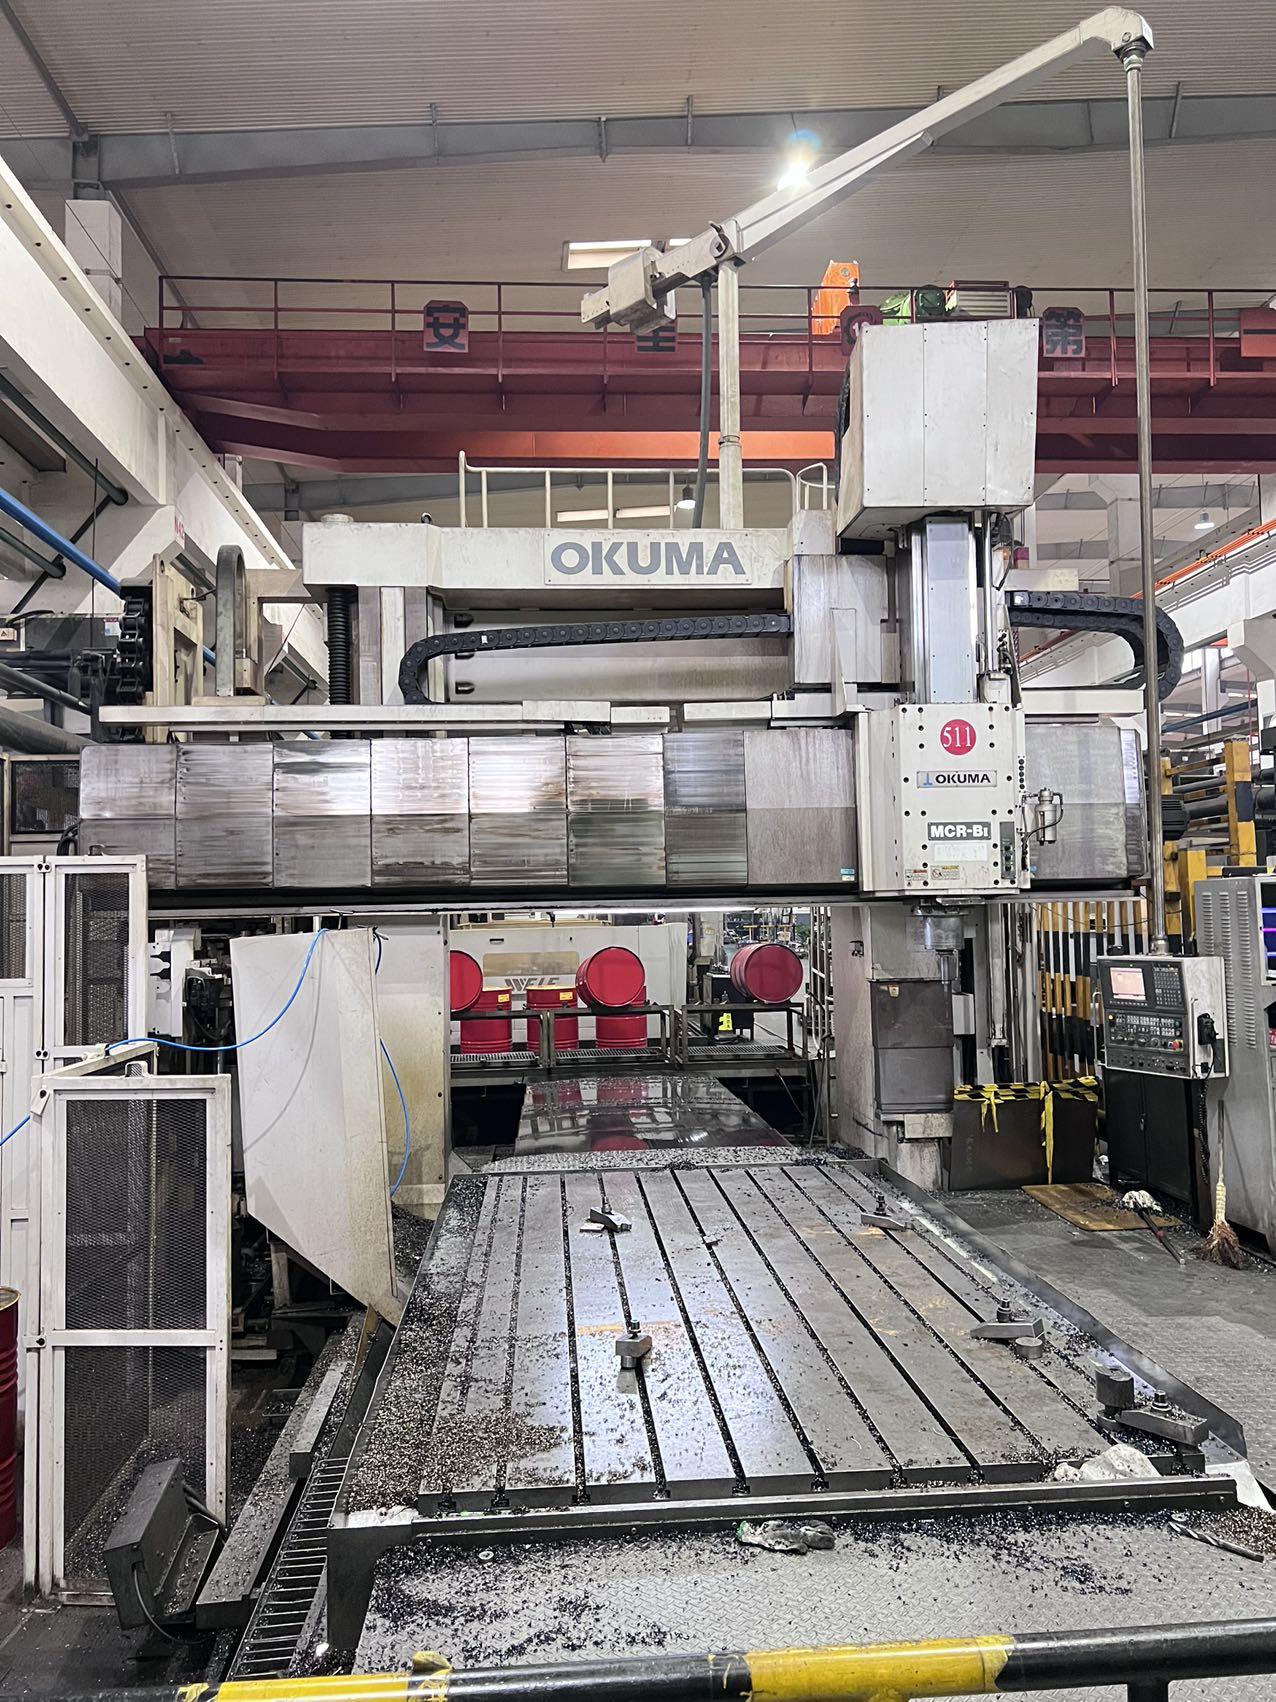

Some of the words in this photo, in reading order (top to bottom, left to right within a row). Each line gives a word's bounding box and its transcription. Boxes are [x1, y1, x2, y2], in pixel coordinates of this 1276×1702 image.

[425, 304, 466, 350] 安
[551, 541, 746, 576] OKUMA
[943, 726, 972, 748] 511
[935, 773, 991, 784] OKUMA
